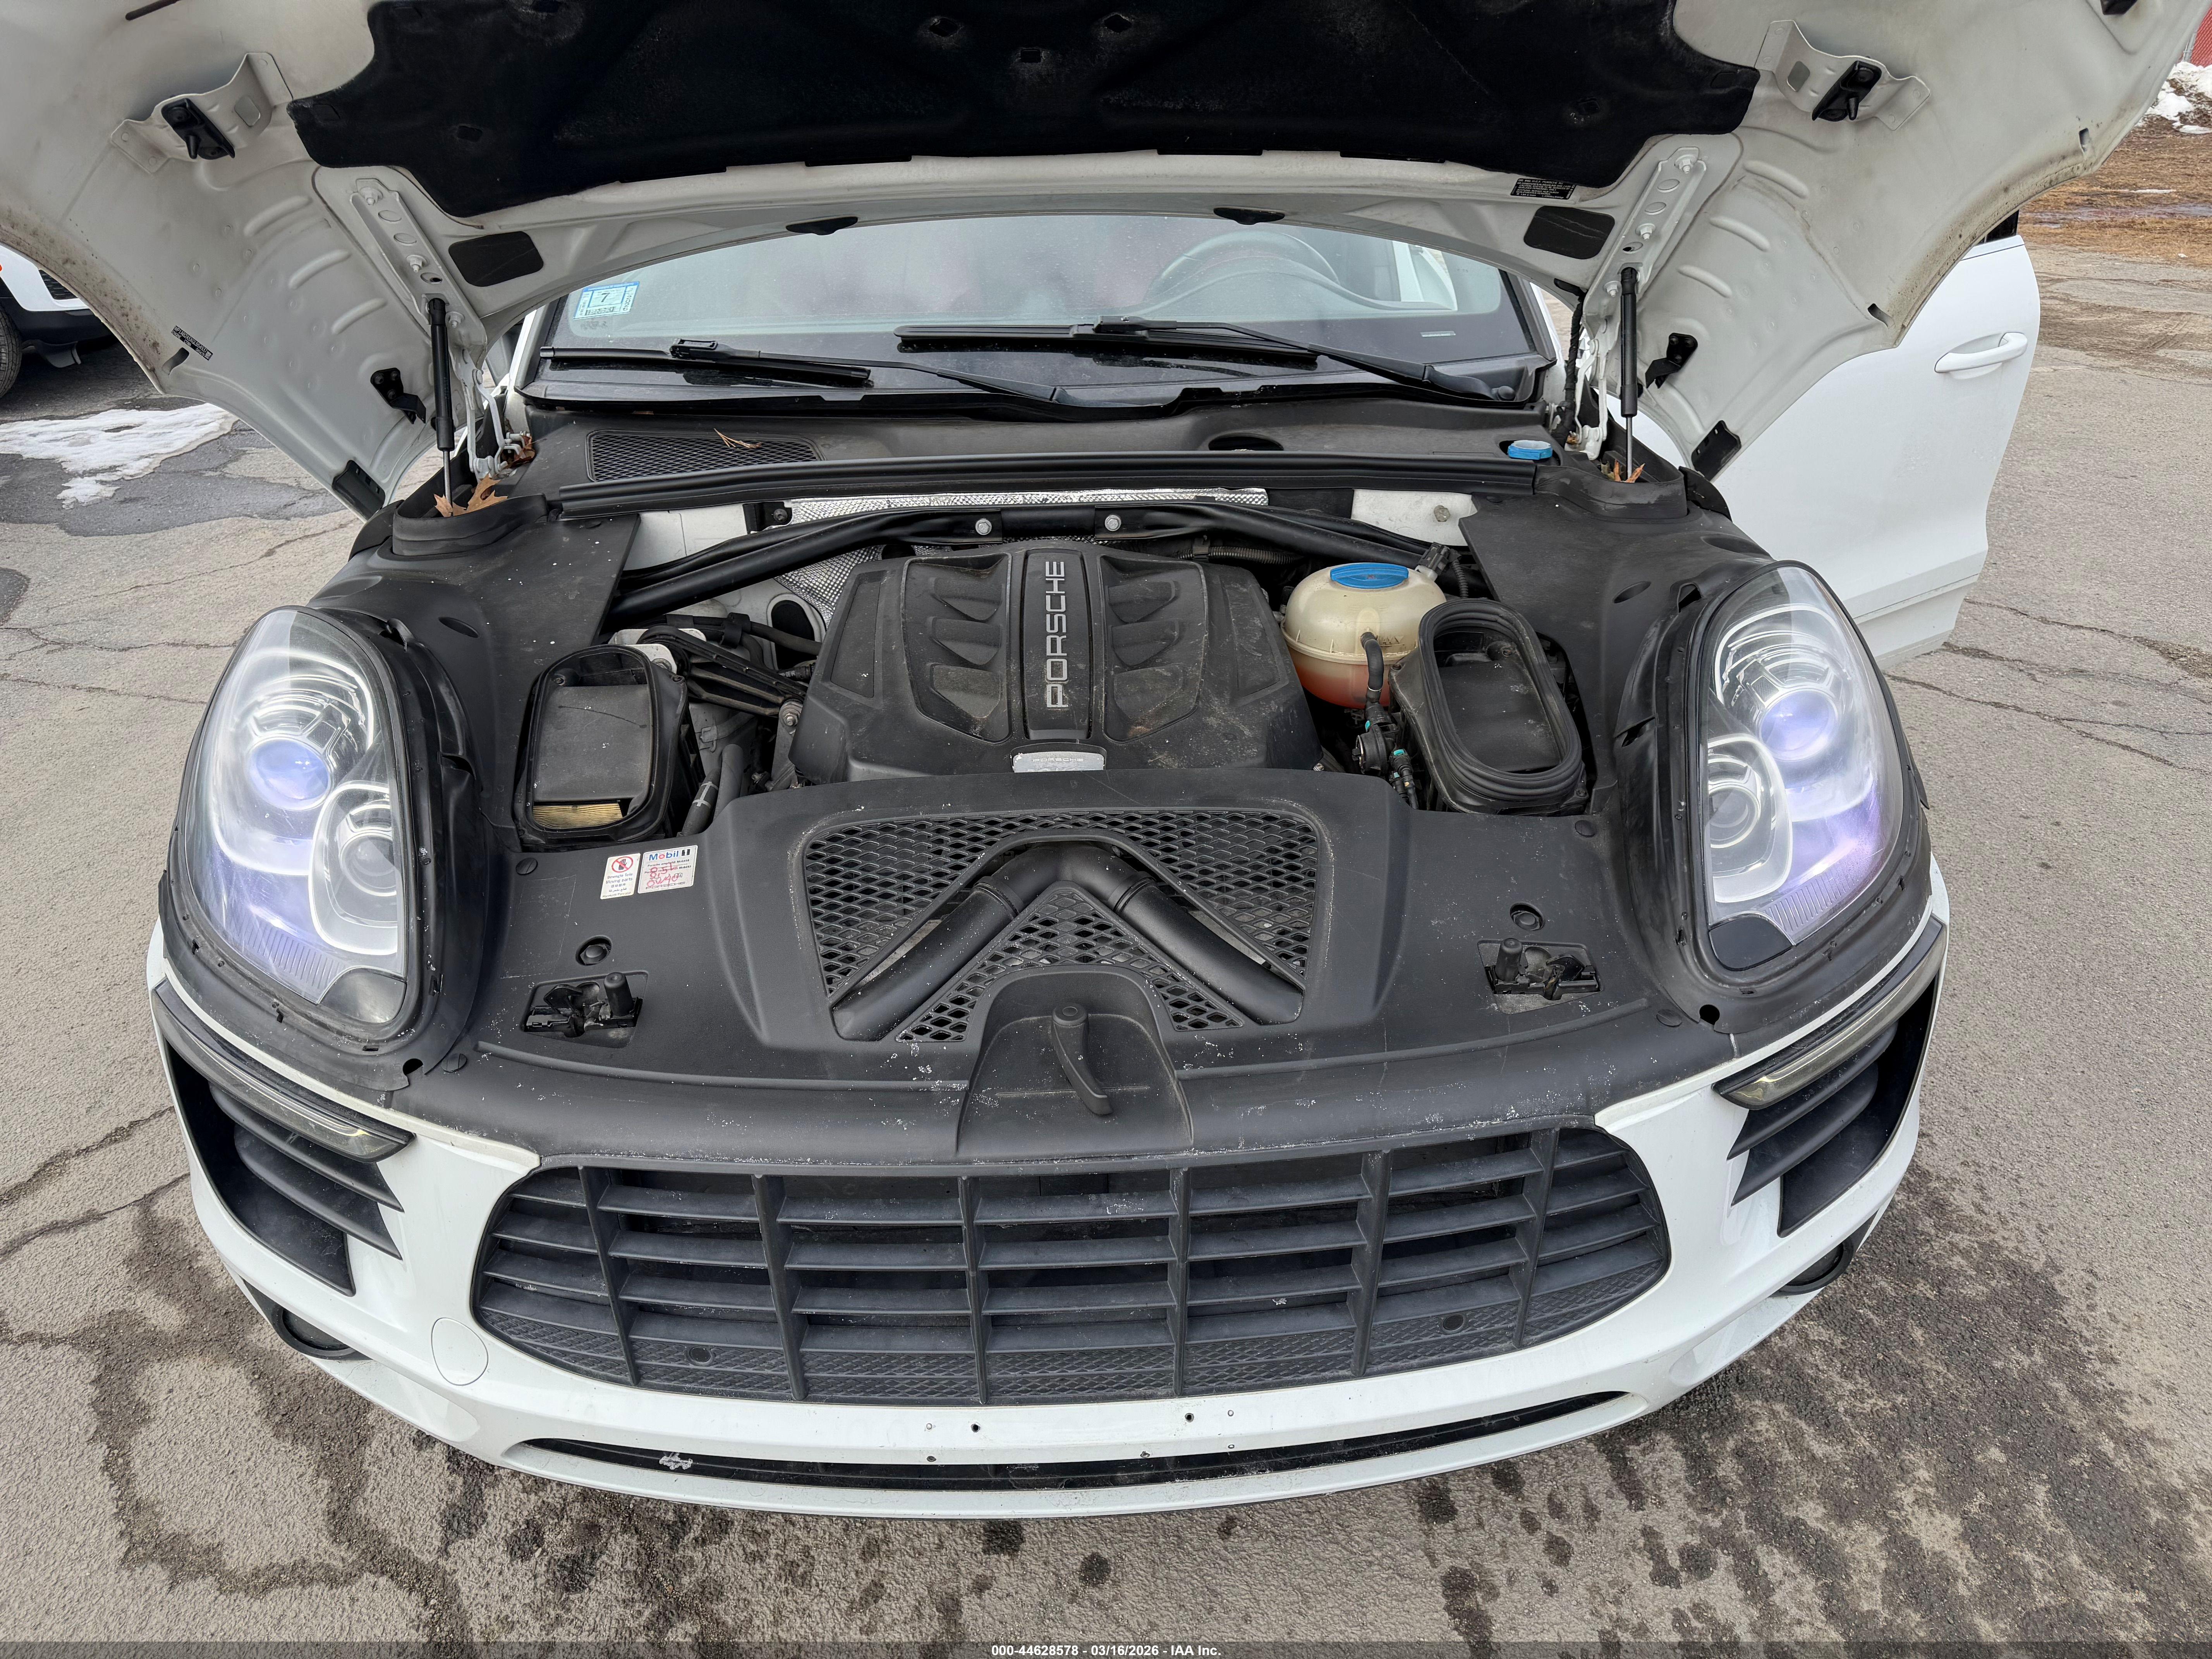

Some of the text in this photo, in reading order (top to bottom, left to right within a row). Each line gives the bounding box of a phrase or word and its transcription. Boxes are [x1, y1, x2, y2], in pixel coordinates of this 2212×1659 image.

[601, 292, 610, 302] 7
[1045, 561, 1068, 708] PORSCHE
[649, 850, 678, 860] Mobil
